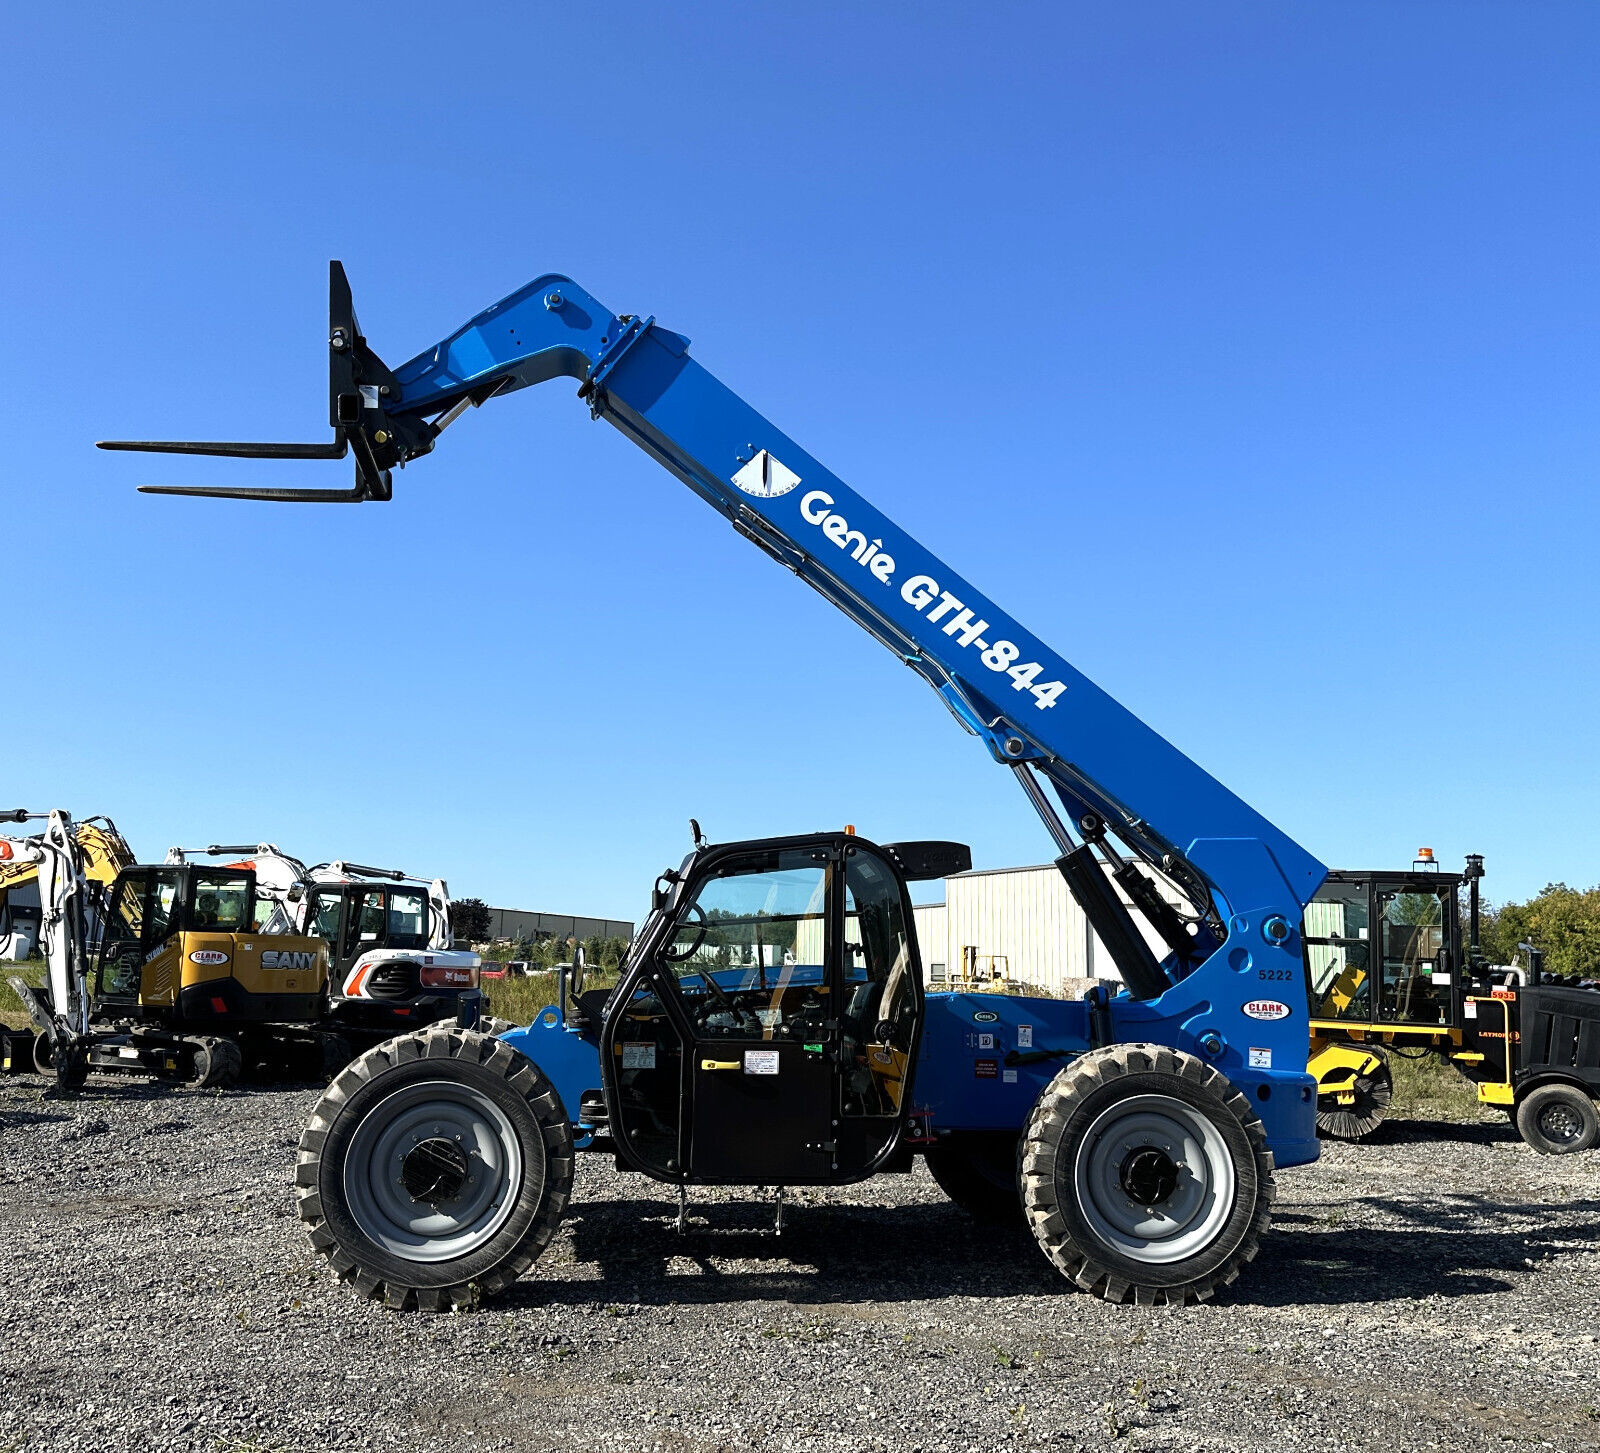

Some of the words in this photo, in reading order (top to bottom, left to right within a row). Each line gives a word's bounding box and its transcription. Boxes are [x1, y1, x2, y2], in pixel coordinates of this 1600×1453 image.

[800, 490, 895, 584] Genie
[900, 575, 1068, 710] GTH-844
[195, 952, 223, 960] CLARK
[261, 950, 317, 970] SANY
[1258, 969, 1293, 981] 5222
[1492, 991, 1515, 999] 5933
[1248, 1003, 1283, 1013] CLARK
